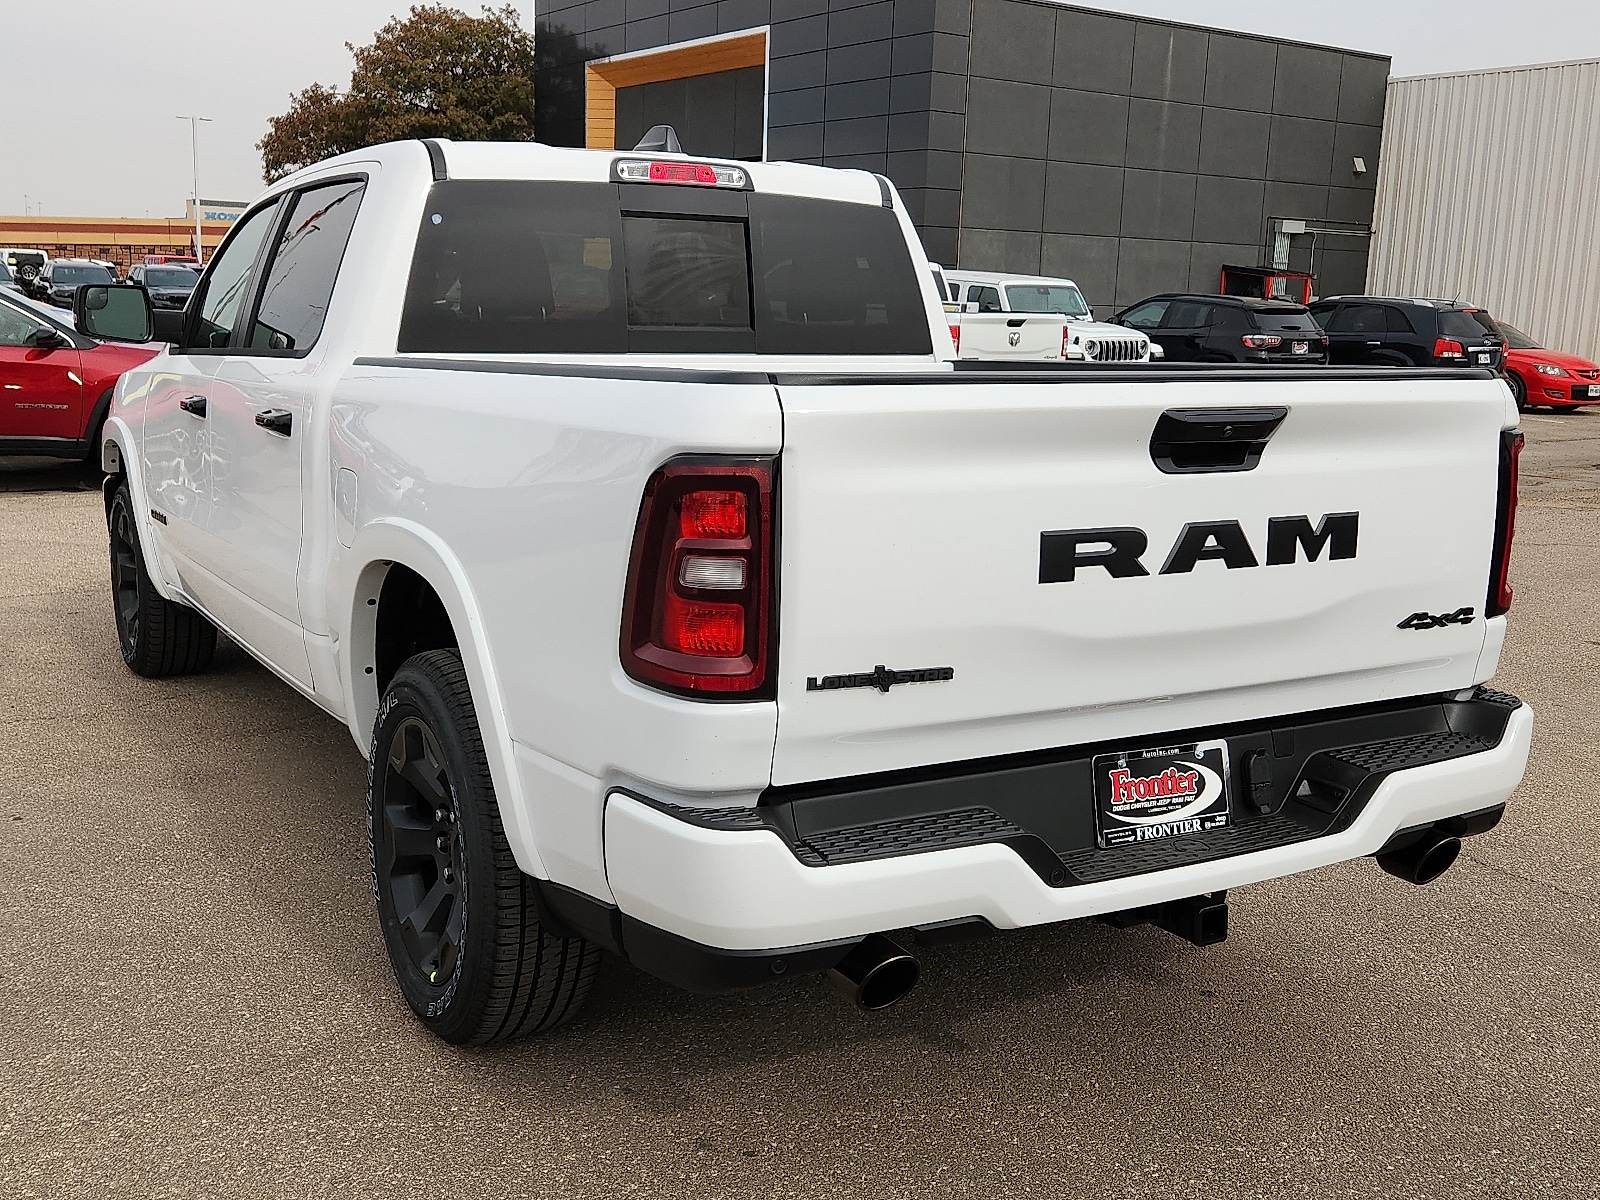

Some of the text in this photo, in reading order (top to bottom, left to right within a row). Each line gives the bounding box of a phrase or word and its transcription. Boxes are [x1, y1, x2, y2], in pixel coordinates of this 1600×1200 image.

[1038, 511, 1360, 584] RAM
[1396, 607, 1476, 630] 4x4
[806, 667, 954, 691] LONE STAR
[1109, 767, 1198, 803] Frontier
[1112, 803, 1131, 812] DODGE
[1131, 800, 1157, 810] CHRYSLER
[1136, 818, 1202, 841] FRONTIER
